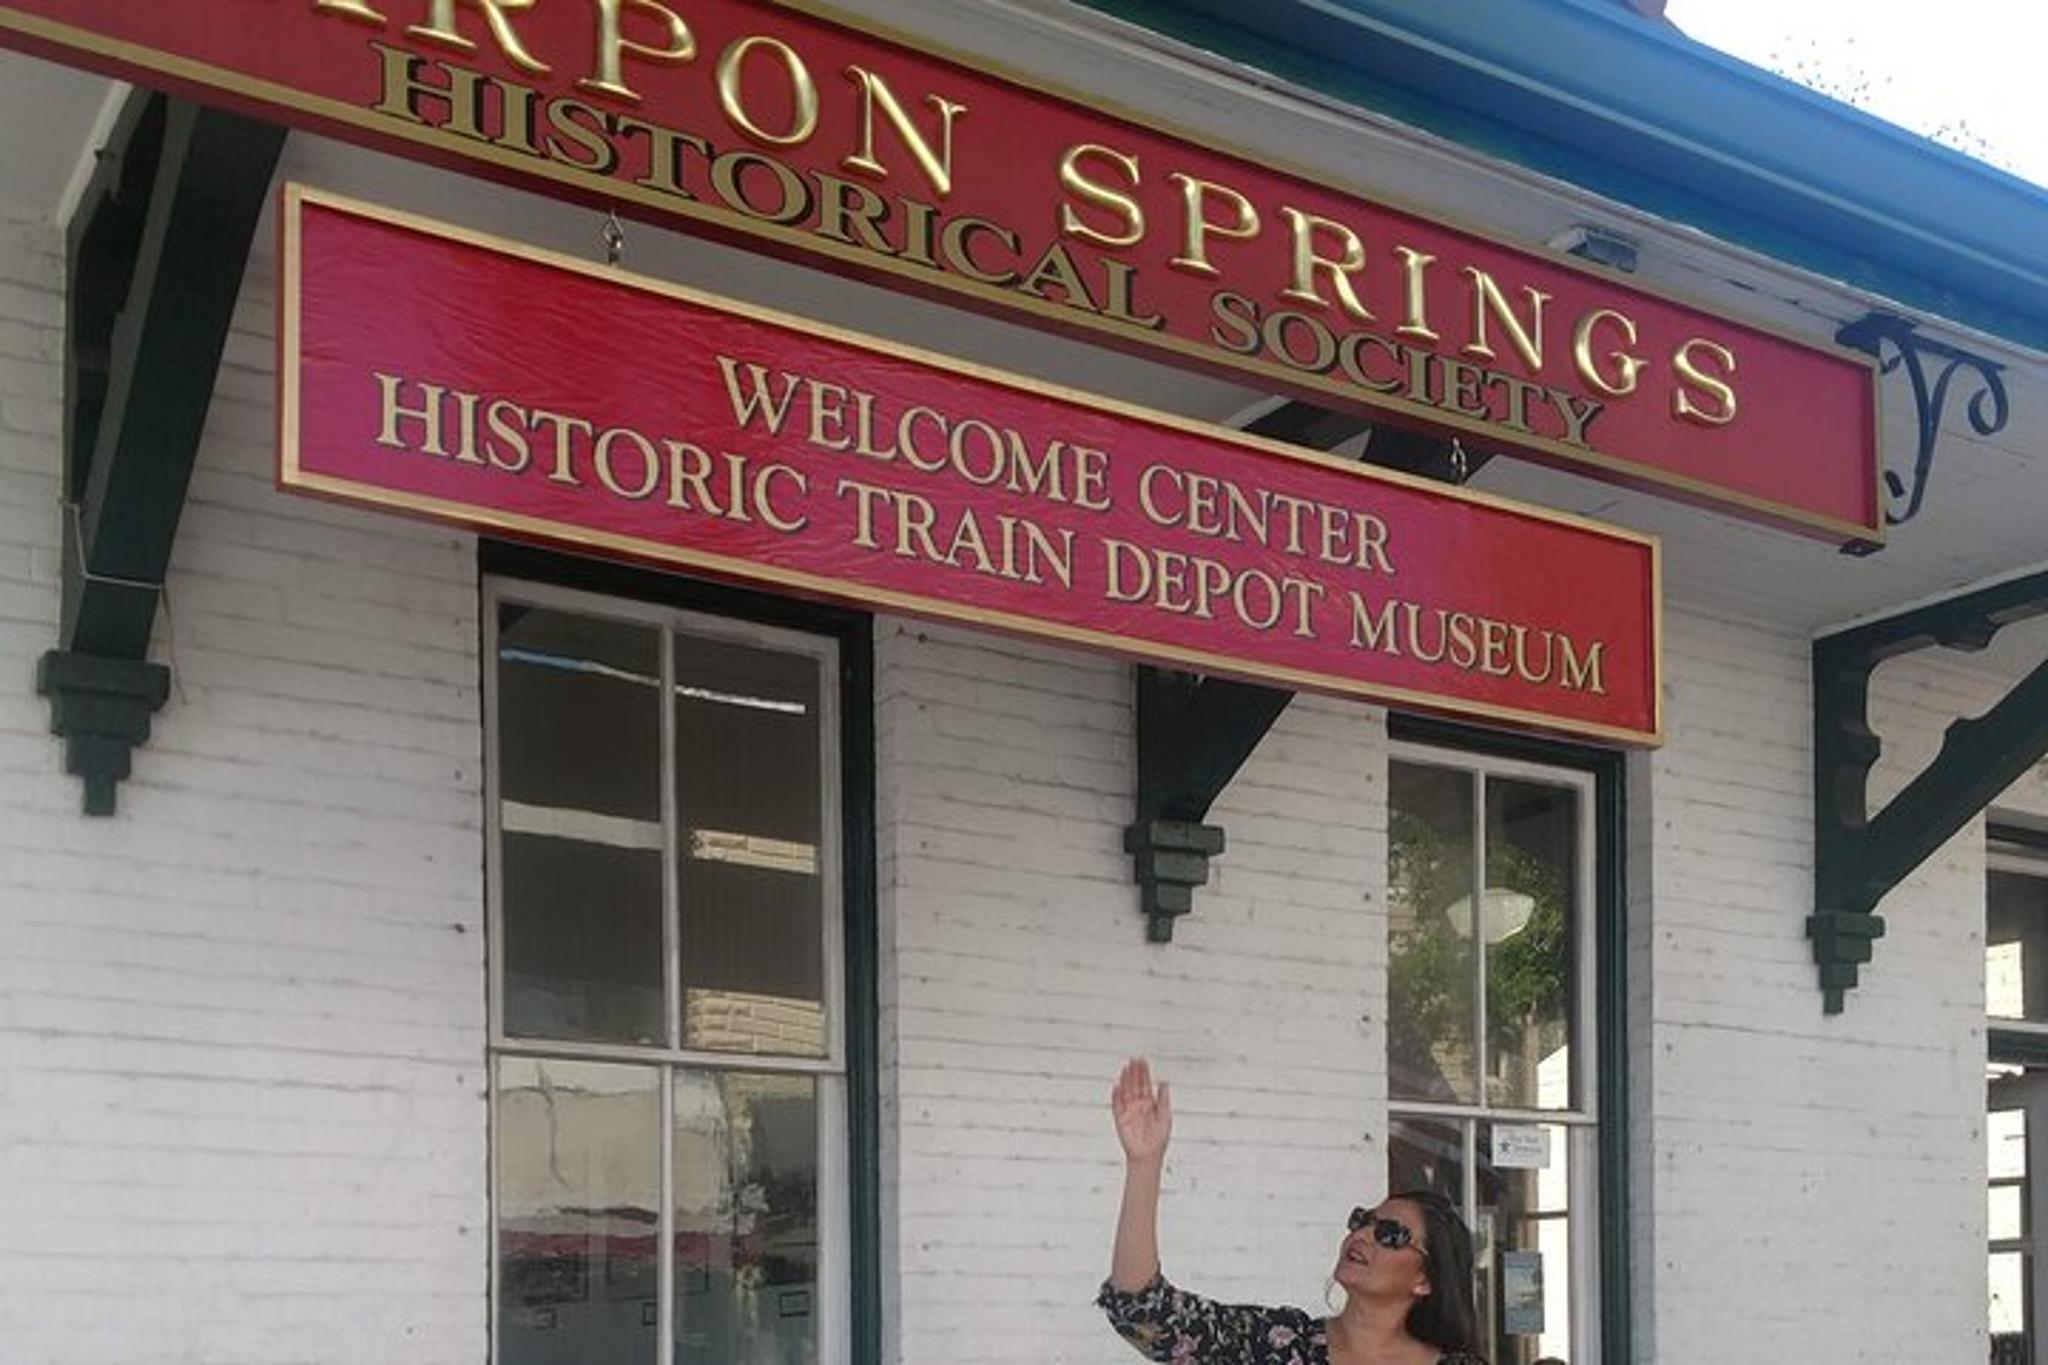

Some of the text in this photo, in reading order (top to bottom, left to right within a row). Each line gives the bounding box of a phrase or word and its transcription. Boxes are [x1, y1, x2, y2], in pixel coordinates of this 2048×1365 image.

[314, 0, 1739, 426] RPON SPRINGS
[370, 42, 1604, 449] HISTORICAL SOCIETY
[374, 371, 1607, 694] HISTORIC TRAIN DEPOT MUSEUM
[716, 354, 1396, 574] WELCOME CENTER
